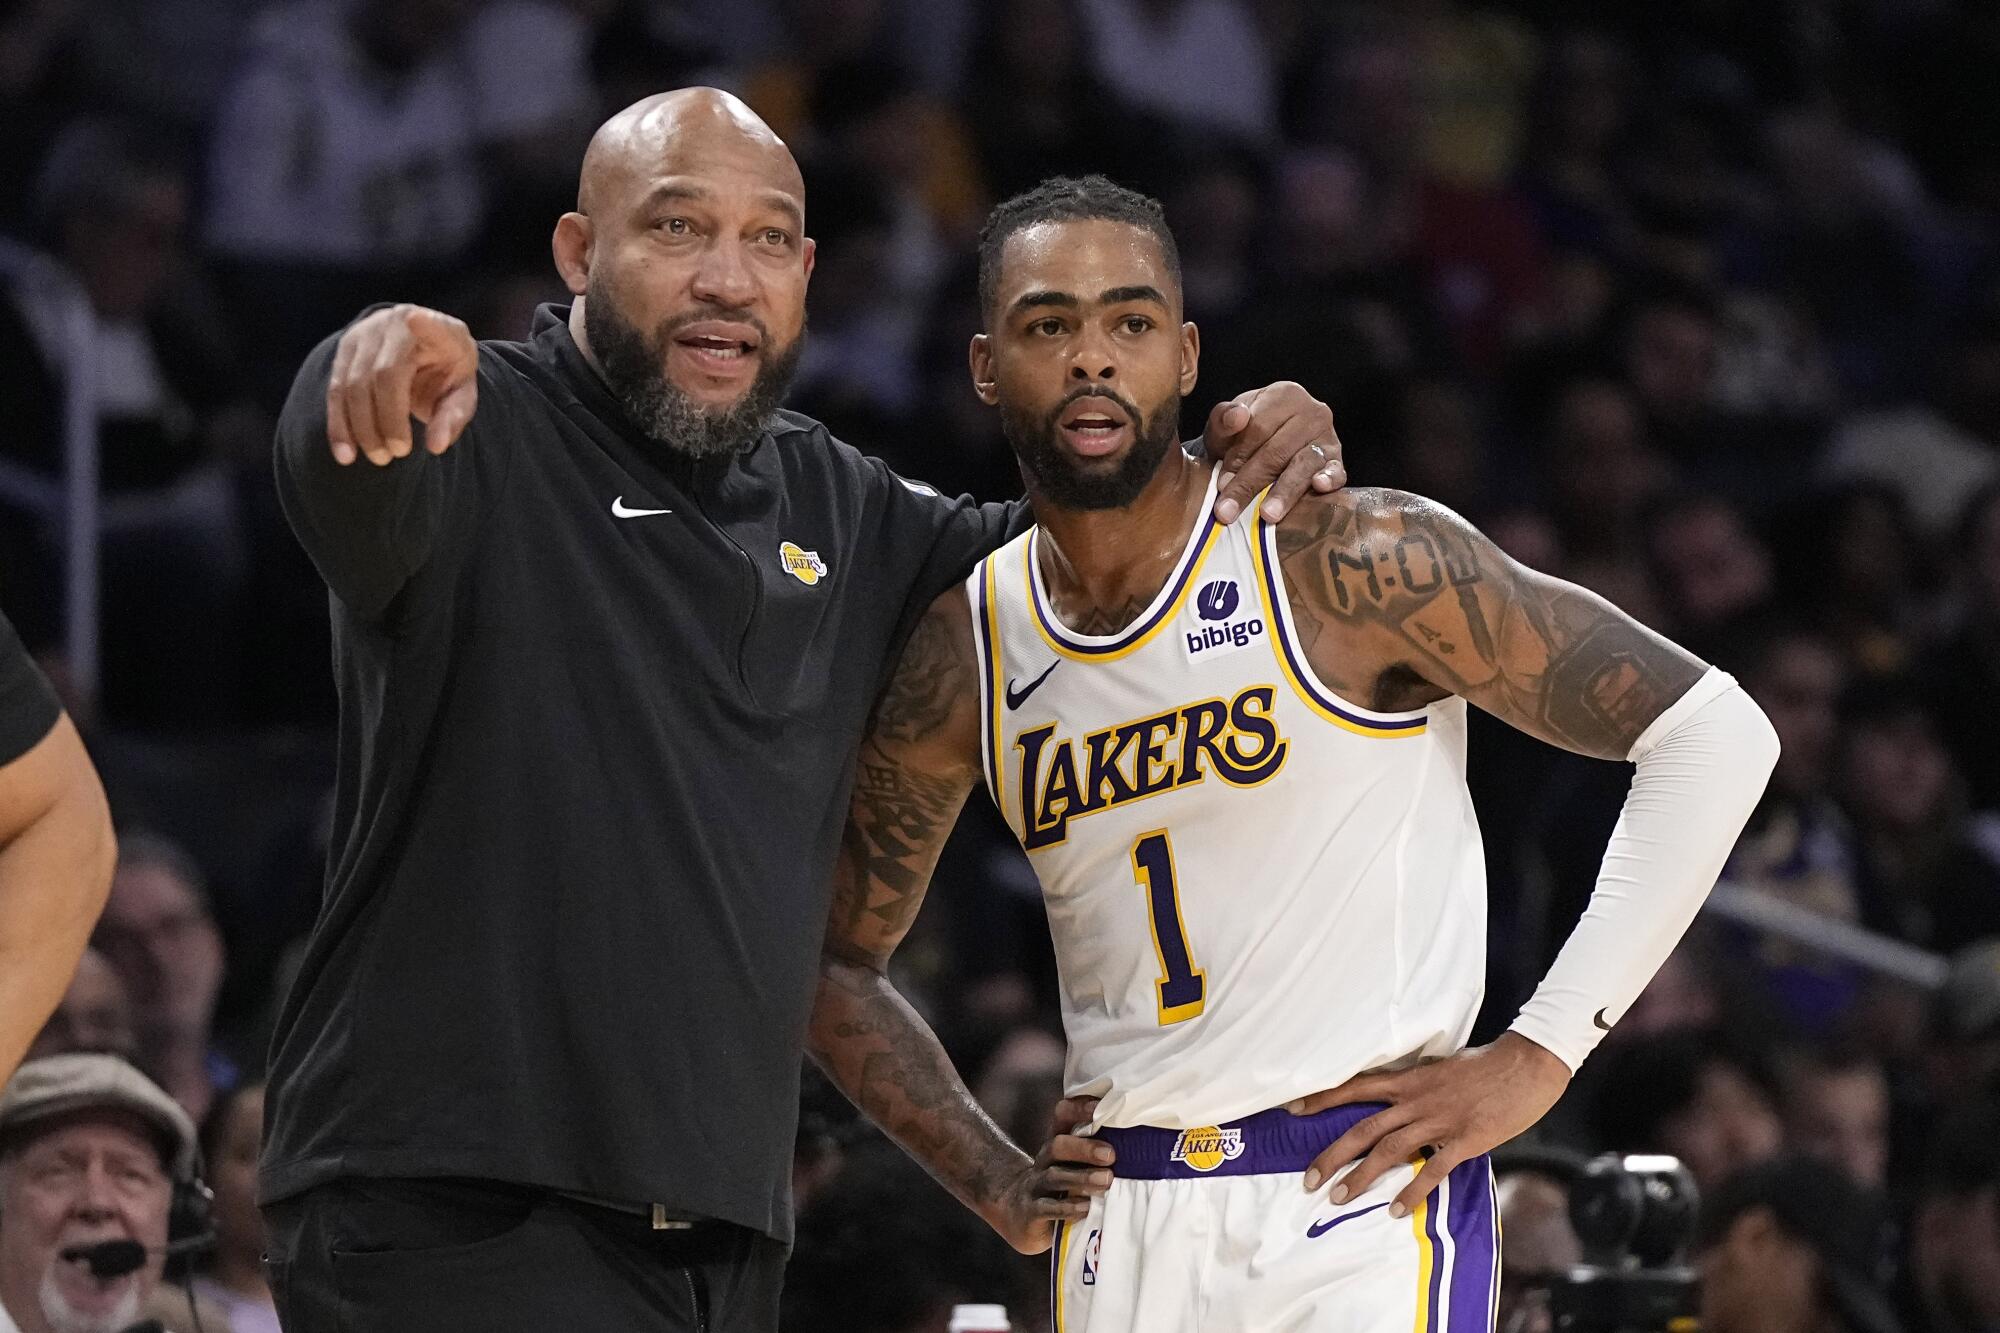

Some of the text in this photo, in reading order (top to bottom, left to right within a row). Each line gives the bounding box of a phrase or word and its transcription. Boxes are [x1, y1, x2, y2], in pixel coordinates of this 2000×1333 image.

[1186, 619, 1263, 654] bibigo
[1013, 684, 1290, 851] LAKERS
[1130, 827, 1207, 1026] 1
[1173, 1134, 1242, 1158] LAKERS
